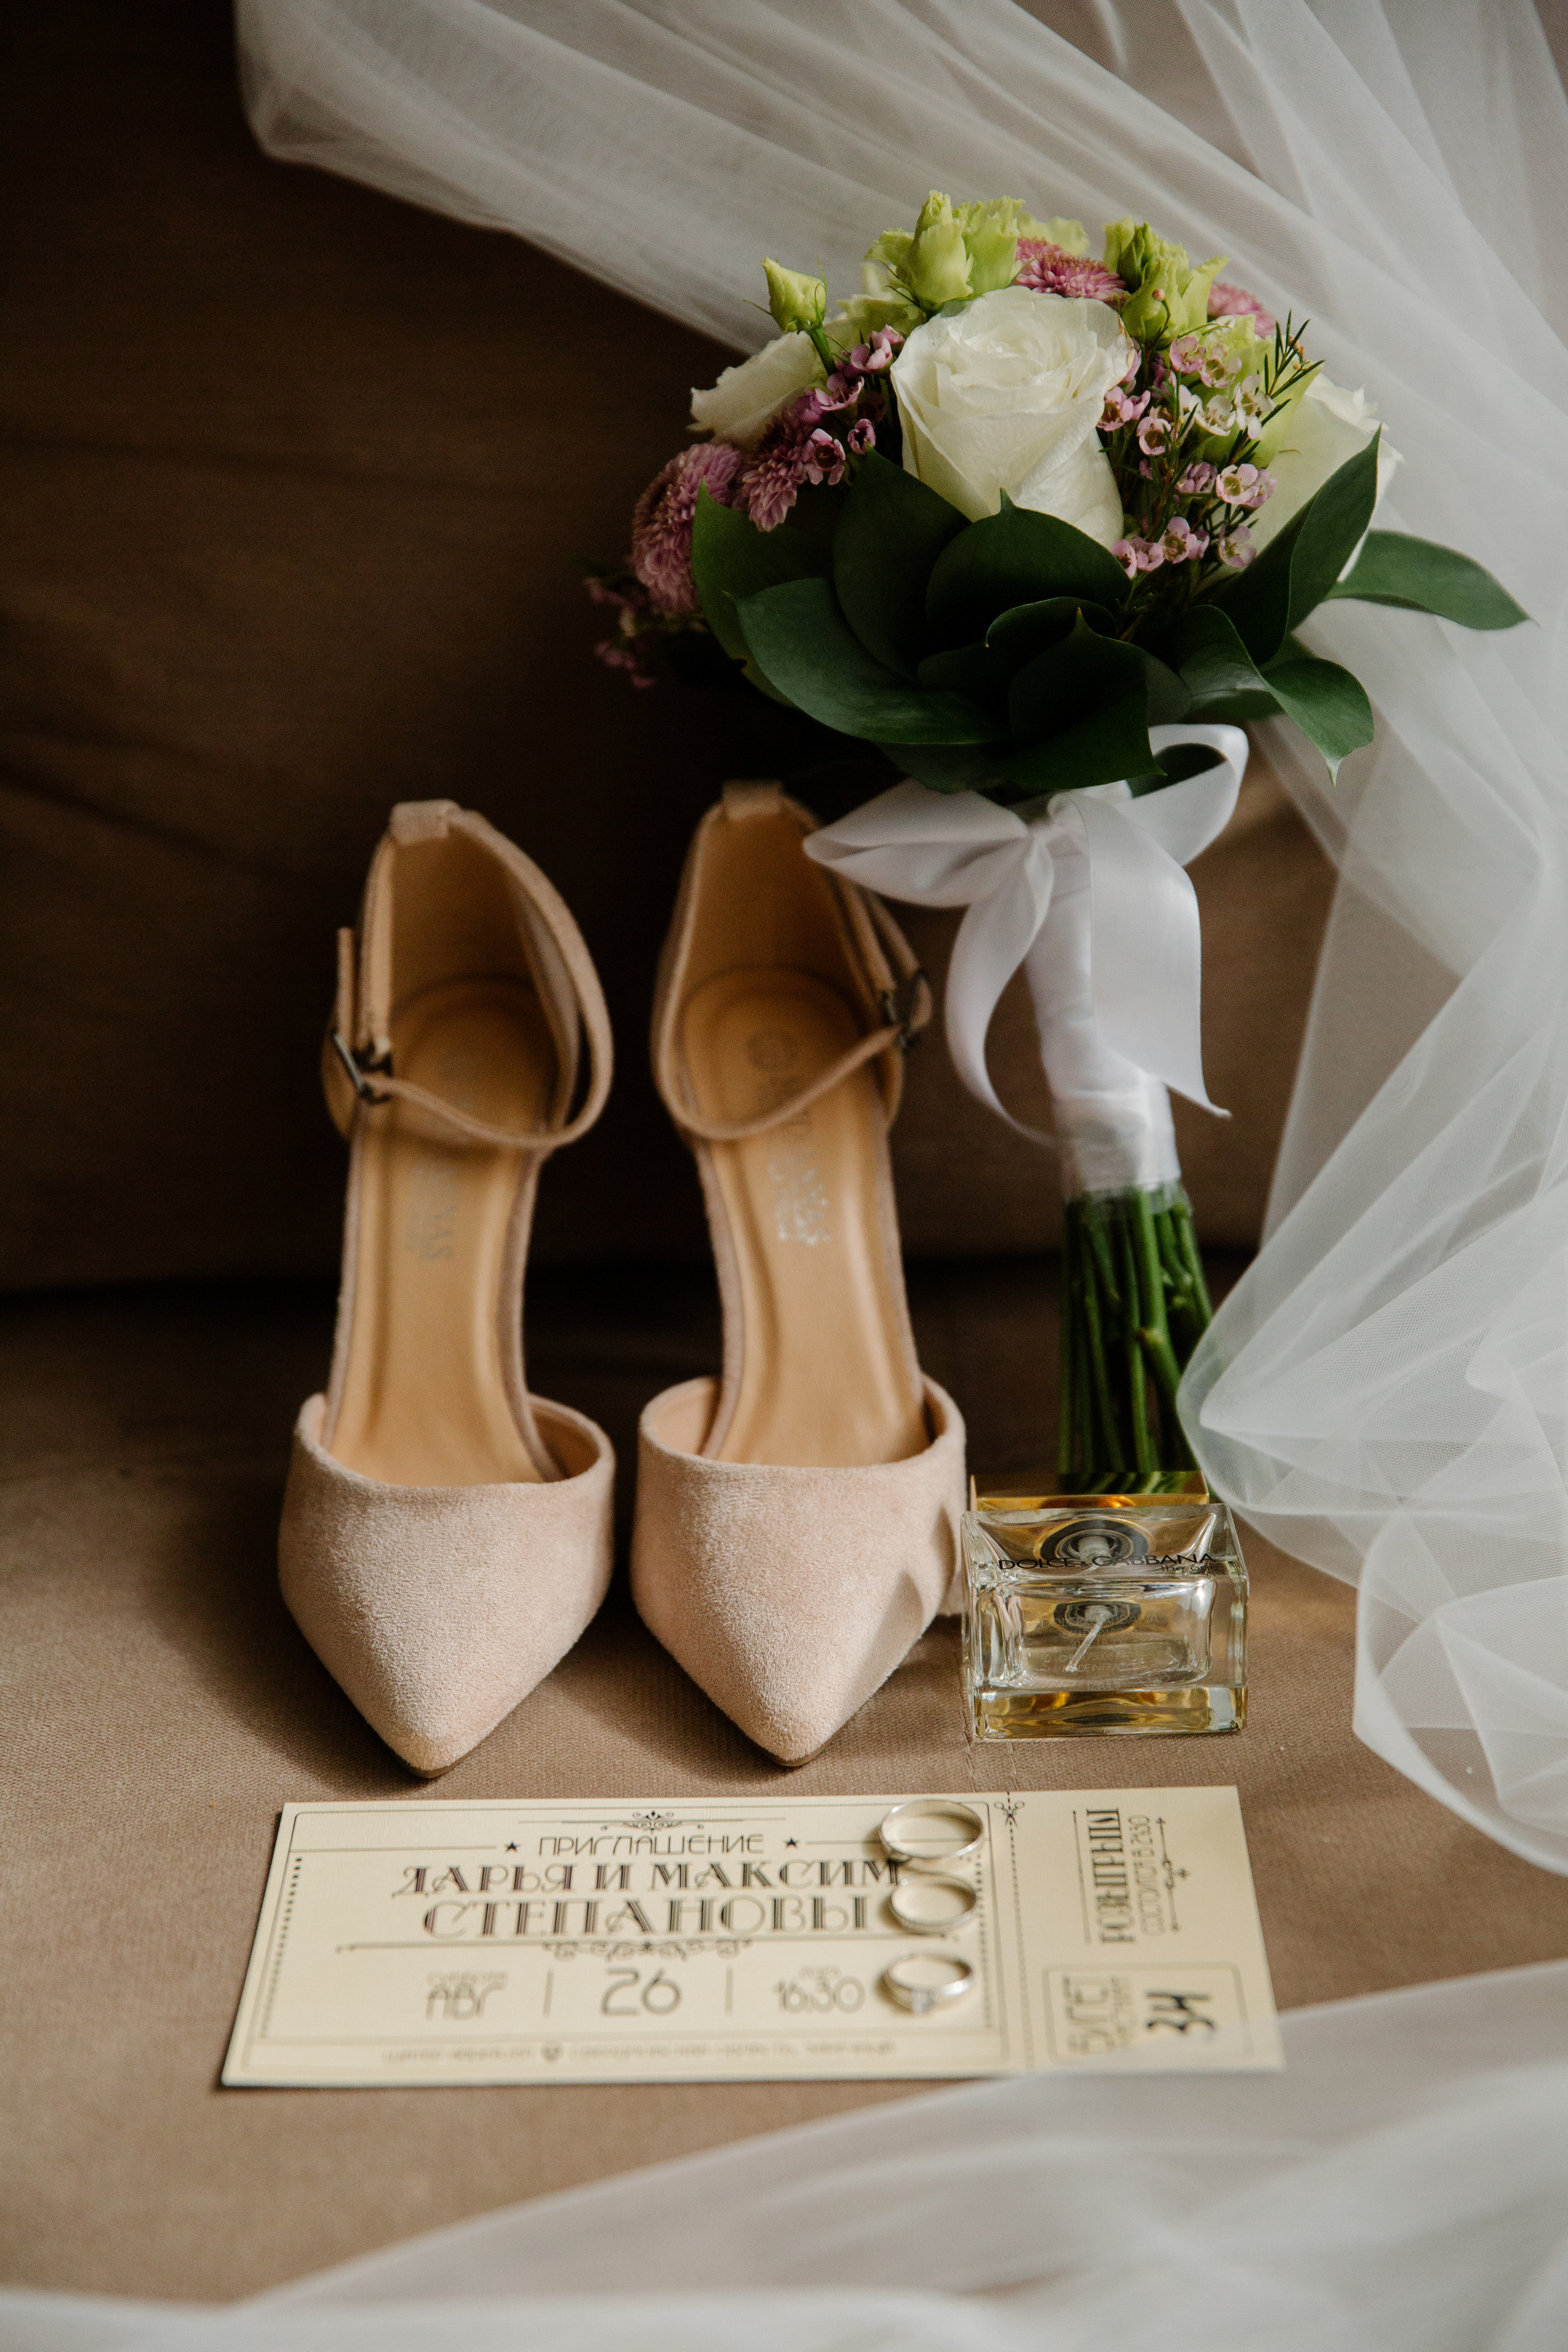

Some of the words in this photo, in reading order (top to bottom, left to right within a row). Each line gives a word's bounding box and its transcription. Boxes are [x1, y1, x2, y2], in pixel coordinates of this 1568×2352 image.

[538, 1834, 763, 1855] ПРИГЛАШЕНИЕ
[392, 1862, 578, 1899] ДАРЬЯ
[589, 1861, 631, 1891] И
[647, 1858, 900, 1891] МАКСИМ
[422, 1894, 868, 1939] СТЕПАНОВЫ
[600, 1967, 682, 2017] 26
